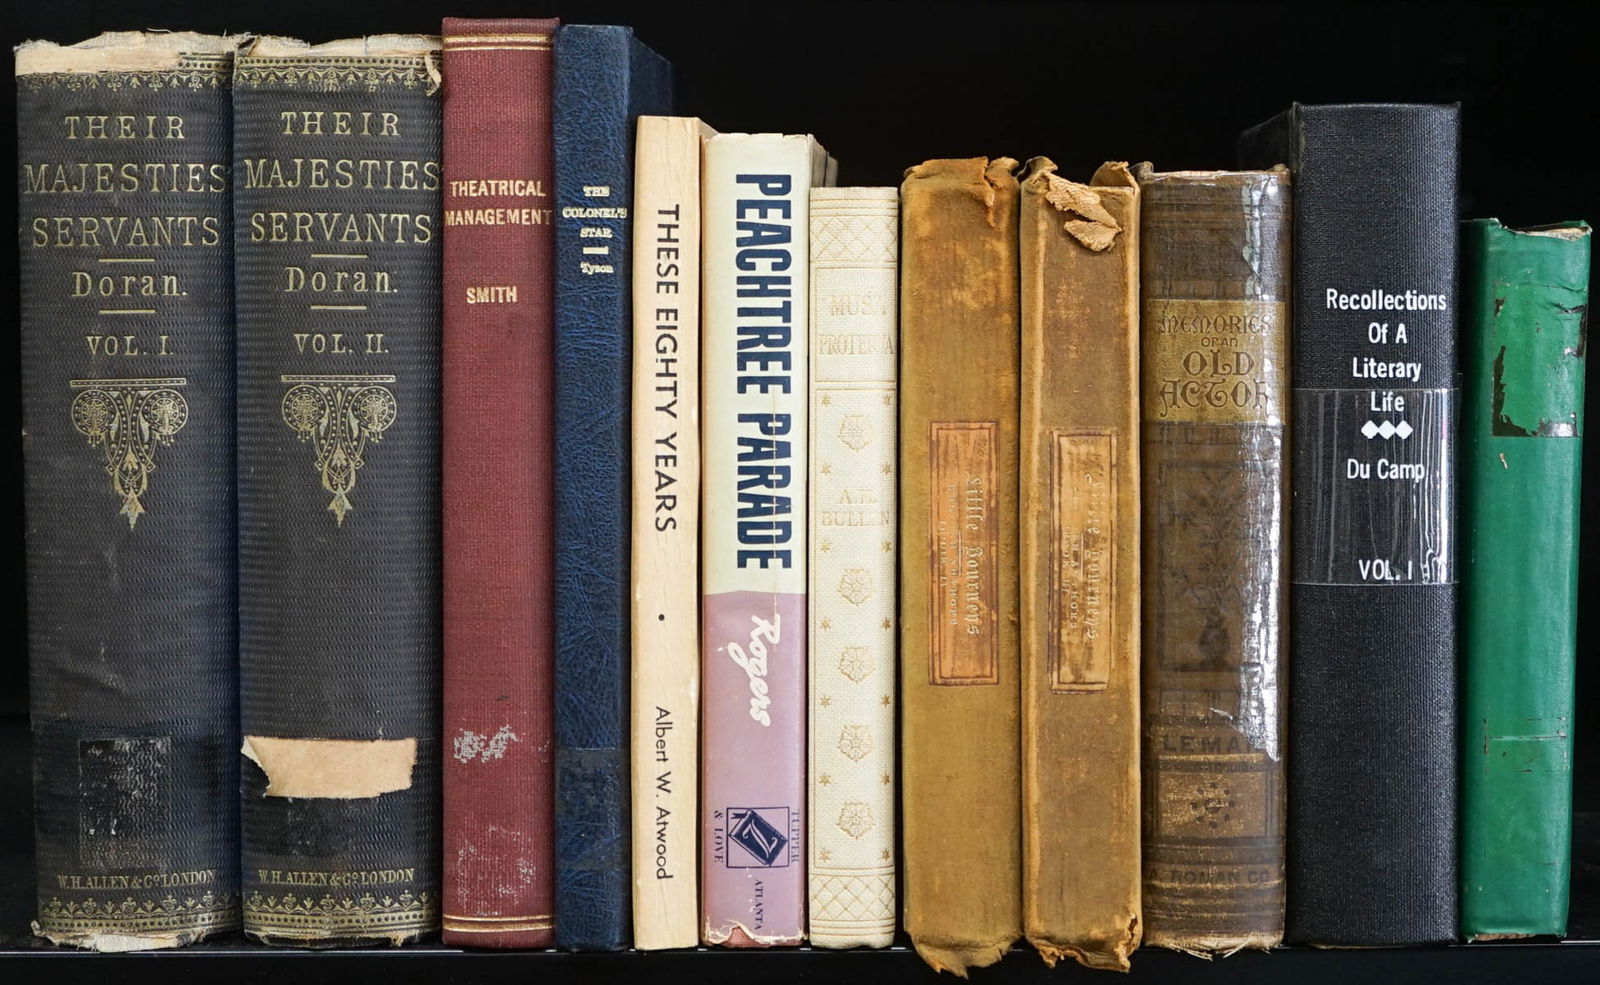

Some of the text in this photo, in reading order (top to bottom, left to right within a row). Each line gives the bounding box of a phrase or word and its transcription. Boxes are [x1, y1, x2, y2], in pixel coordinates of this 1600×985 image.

[65, 115, 186, 139] THEIR
[281, 111, 400, 136] THEIR
[24, 164, 226, 193] MAJESTIES
[244, 159, 440, 190] MAJESTIES
[450, 180, 546, 197] THEATRICAL
[583, 185, 610, 197] THE
[250, 213, 431, 244] SERVANTS
[445, 208, 552, 226] MANAGEMENT
[33, 216, 219, 247] SERVANTS
[580, 227, 613, 238] STAR
[284, 267, 399, 293] Doran.
[580, 261, 614, 275] Tyson
[72, 272, 188, 297] Doran.
[466, 286, 518, 304] SMITH
[1326, 288, 1447, 311] Recollections
[1160, 314, 1272, 334] MEMORIES
[1368, 323, 1408, 344] Of A
[1201, 337, 1238, 348] OF AN
[655, 204, 680, 532] THESE EIGHTY YEARS
[736, 174, 792, 569] PEACHTREE PARADE
[1183, 350, 1255, 377] OLD
[1352, 357, 1422, 381] Literary
[1160, 379, 1270, 417] ACTOR
[1371, 391, 1405, 412] Life
[1347, 459, 1426, 483] Du Camp
[966, 473, 984, 530] Little
[1358, 559, 1401, 581] VOL.
[727, 612, 781, 727] Rogers
[655, 706, 674, 880] Albert W. Atwood
[714, 809, 724, 864] & LOVE
[790, 808, 801, 863] TUPPER
[162, 868, 217, 888] LONDON
[360, 868, 415, 885] LONDON
[753, 879, 765, 931] ATLANTA
